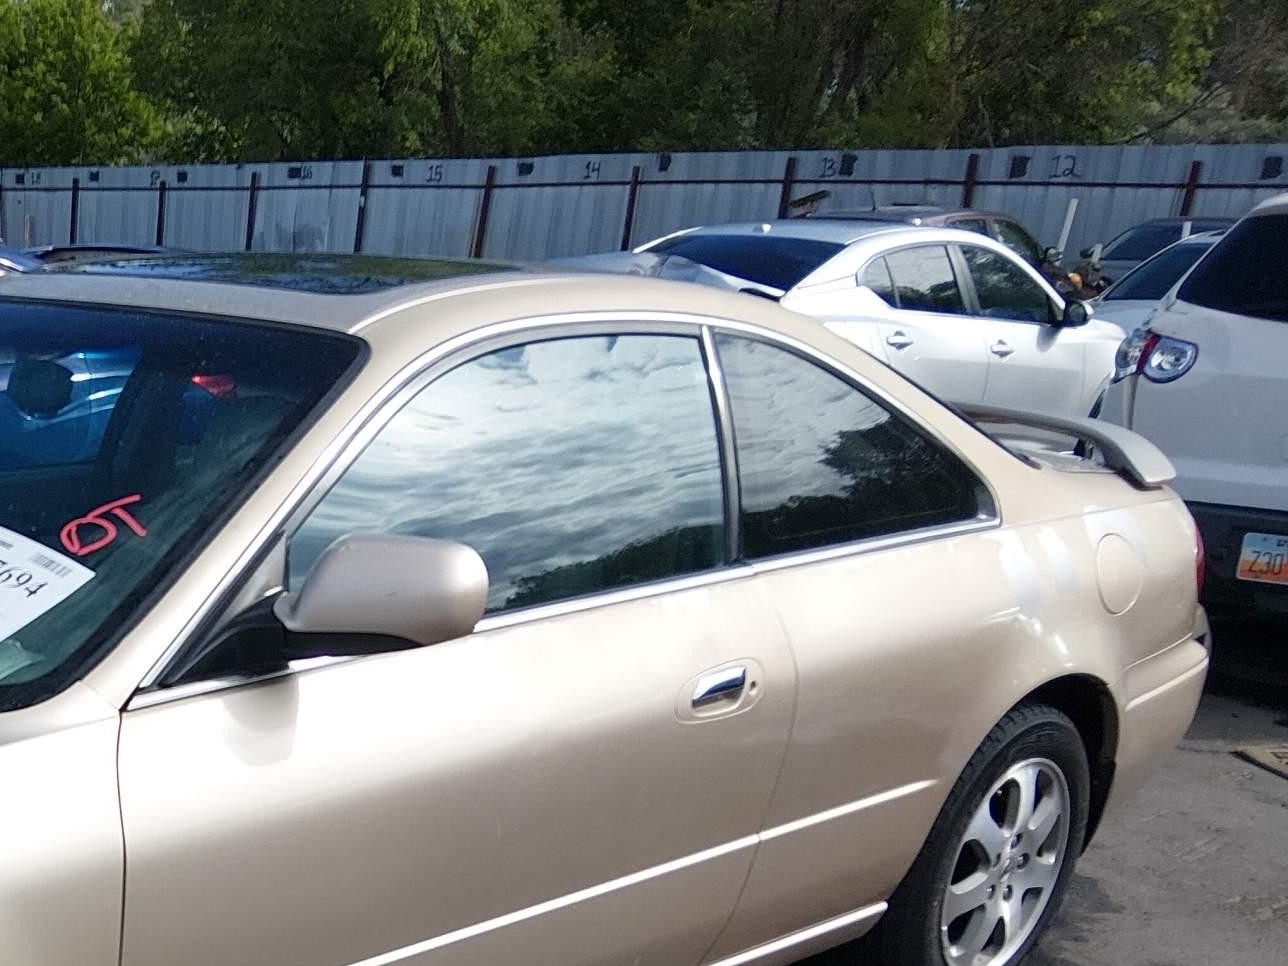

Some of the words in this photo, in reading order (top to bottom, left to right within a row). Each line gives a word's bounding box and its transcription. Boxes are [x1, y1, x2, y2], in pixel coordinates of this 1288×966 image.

[425, 164, 444, 183] 15
[583, 160, 601, 180] 14
[818, 156, 837, 178] 13
[1047, 154, 1080, 178] 12
